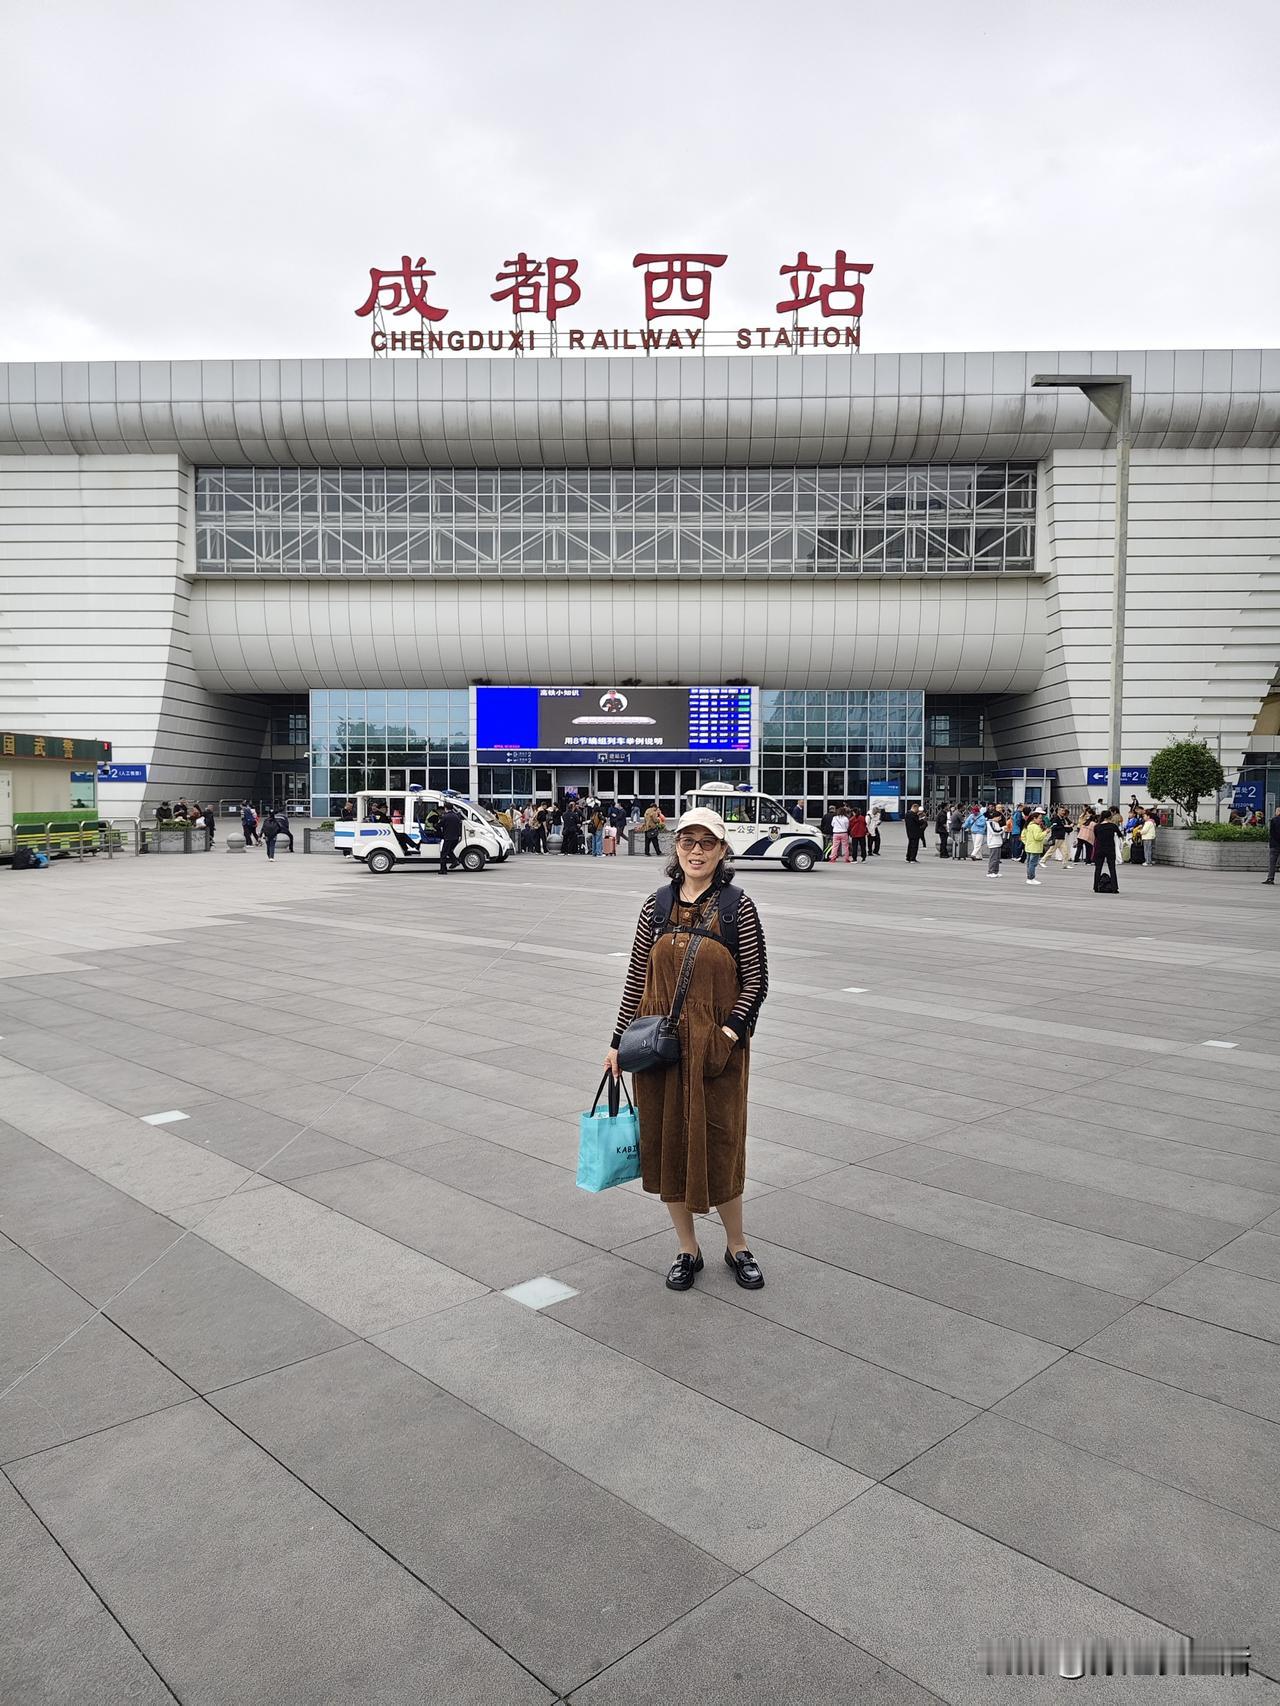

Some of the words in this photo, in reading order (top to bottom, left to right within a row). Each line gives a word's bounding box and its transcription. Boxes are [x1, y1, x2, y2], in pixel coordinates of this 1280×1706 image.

[355, 249, 874, 321] 成都西站
[371, 330, 535, 351] CHENGDUXI
[569, 328, 701, 350] RAILWAY
[736, 326, 861, 349] STATION
[736, 825, 756, 835] 公安
